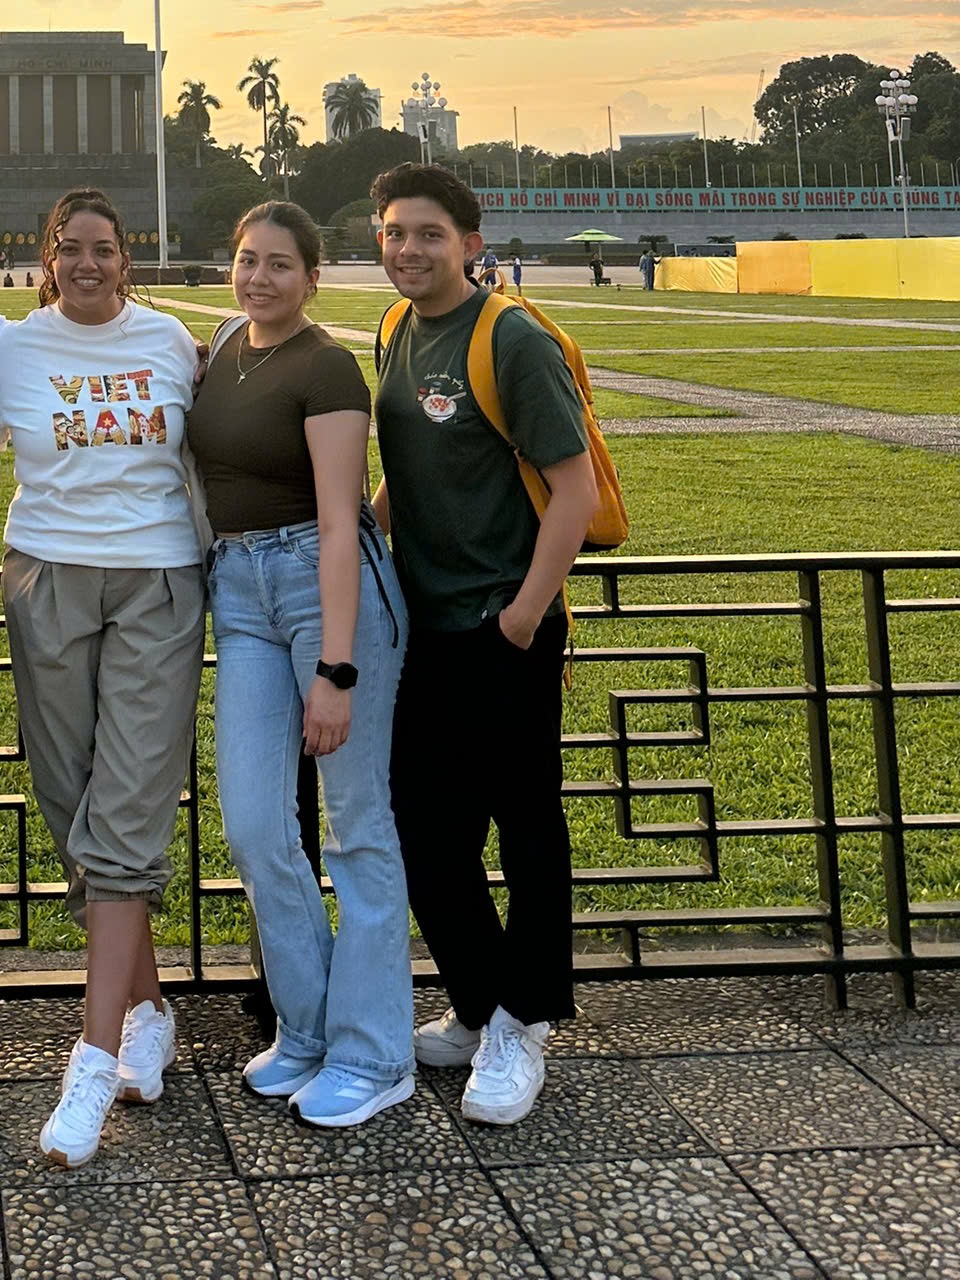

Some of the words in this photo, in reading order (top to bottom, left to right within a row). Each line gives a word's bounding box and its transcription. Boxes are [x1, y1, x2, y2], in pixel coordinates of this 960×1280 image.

[476, 192, 504, 208] ỊCH
[563, 192, 600, 207] MINH
[655, 187, 693, 207] SỐNG
[699, 190, 725, 207] MÃI
[731, 192, 777, 207] TRONG
[805, 189, 856, 208] NGHIỆP
[48, 369, 154, 405] VIET
[52, 405, 167, 451] NAM
